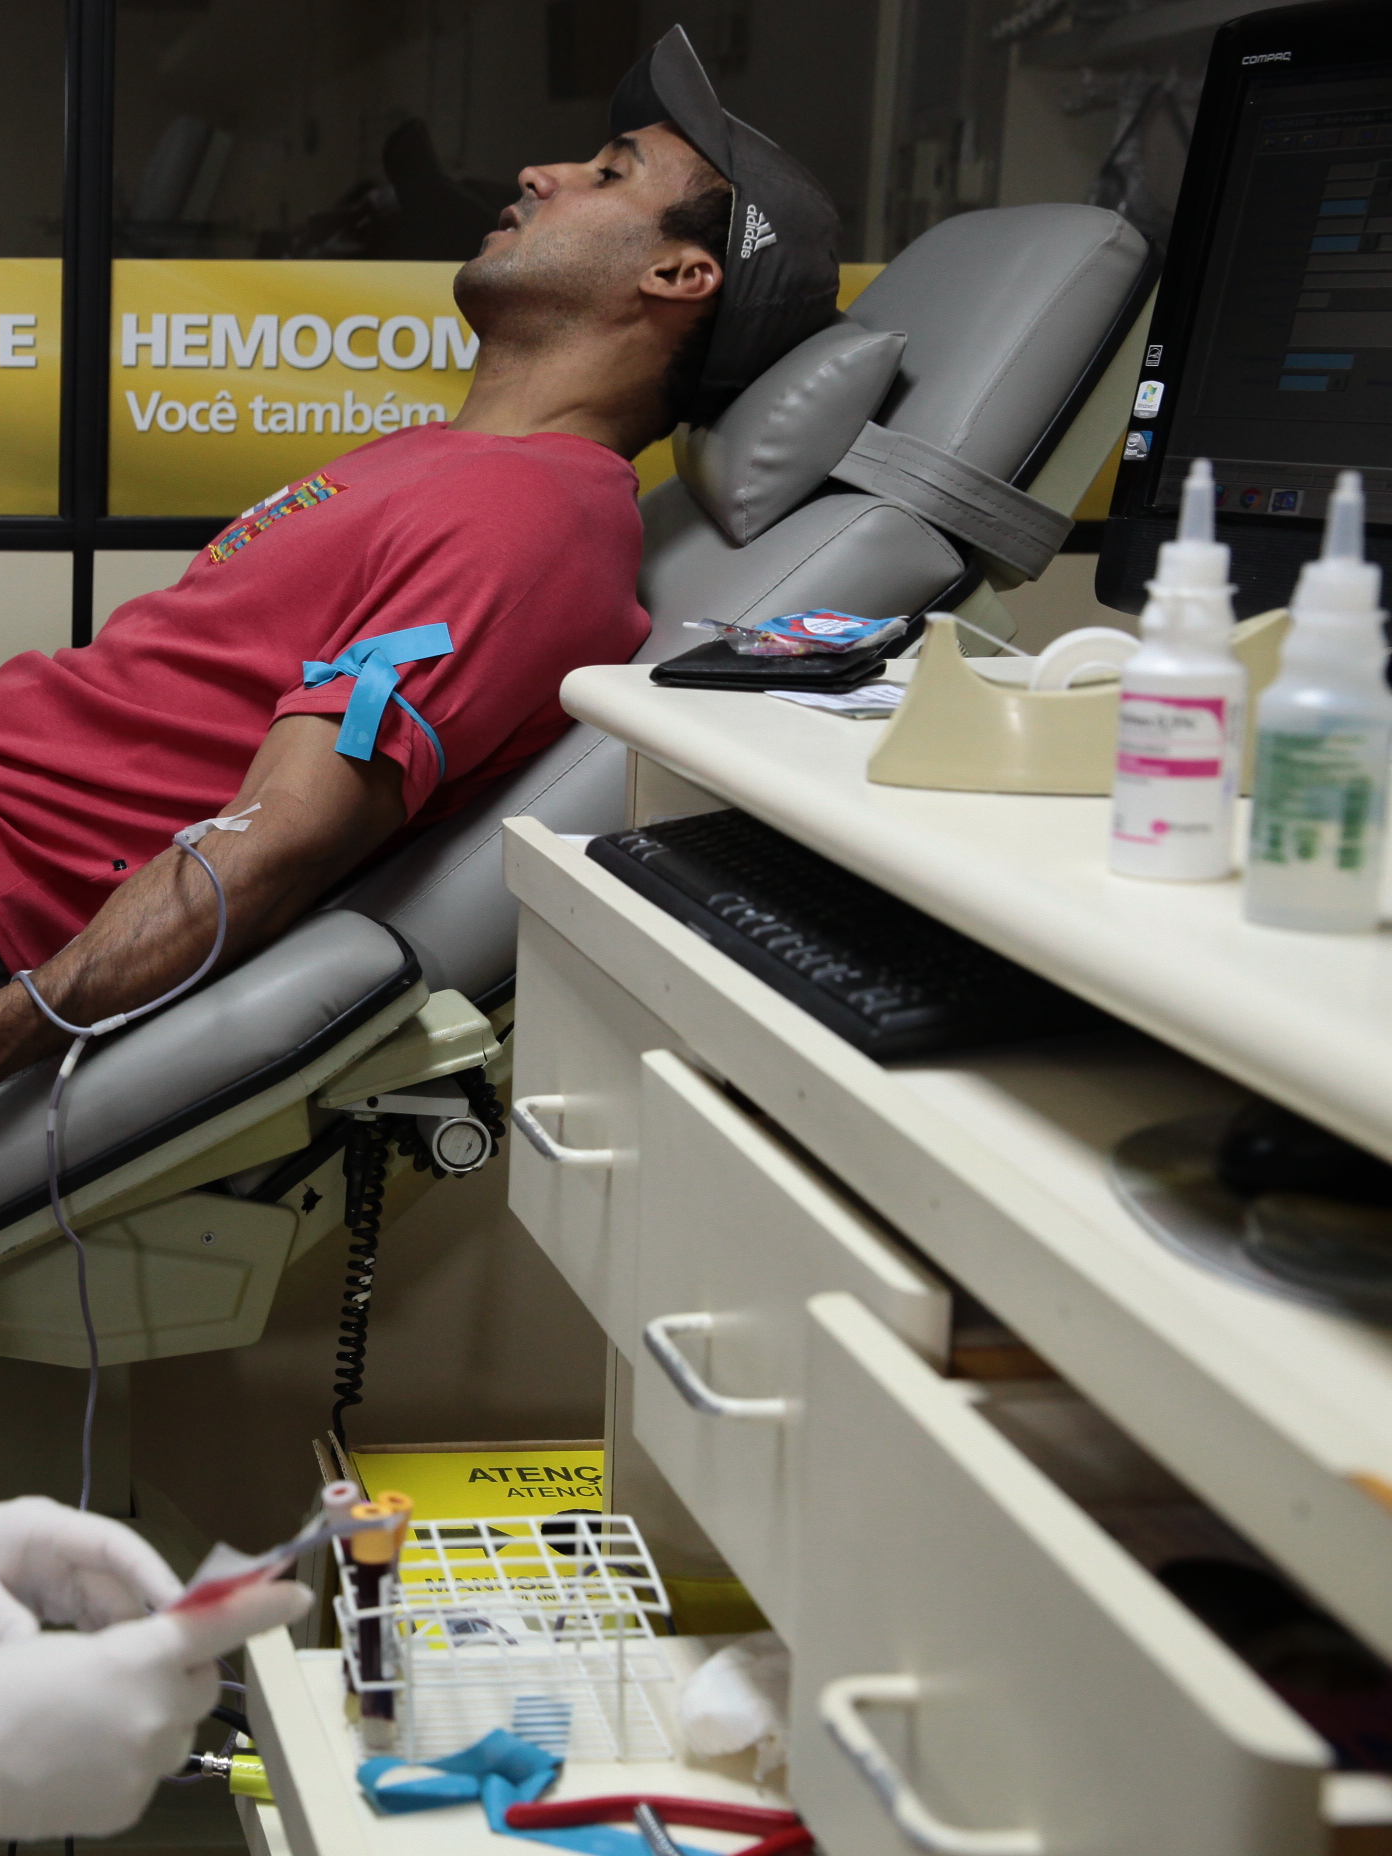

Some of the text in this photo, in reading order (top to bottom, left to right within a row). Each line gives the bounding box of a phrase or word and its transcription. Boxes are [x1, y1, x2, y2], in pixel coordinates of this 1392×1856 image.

[1241, 51, 1292, 66] COMPAQ
[740, 203, 760, 259] adidas
[120, 312, 481, 371] HEMOCOM
[124, 390, 446, 434] Você também
[468, 1465, 603, 1486] ATENÇ
